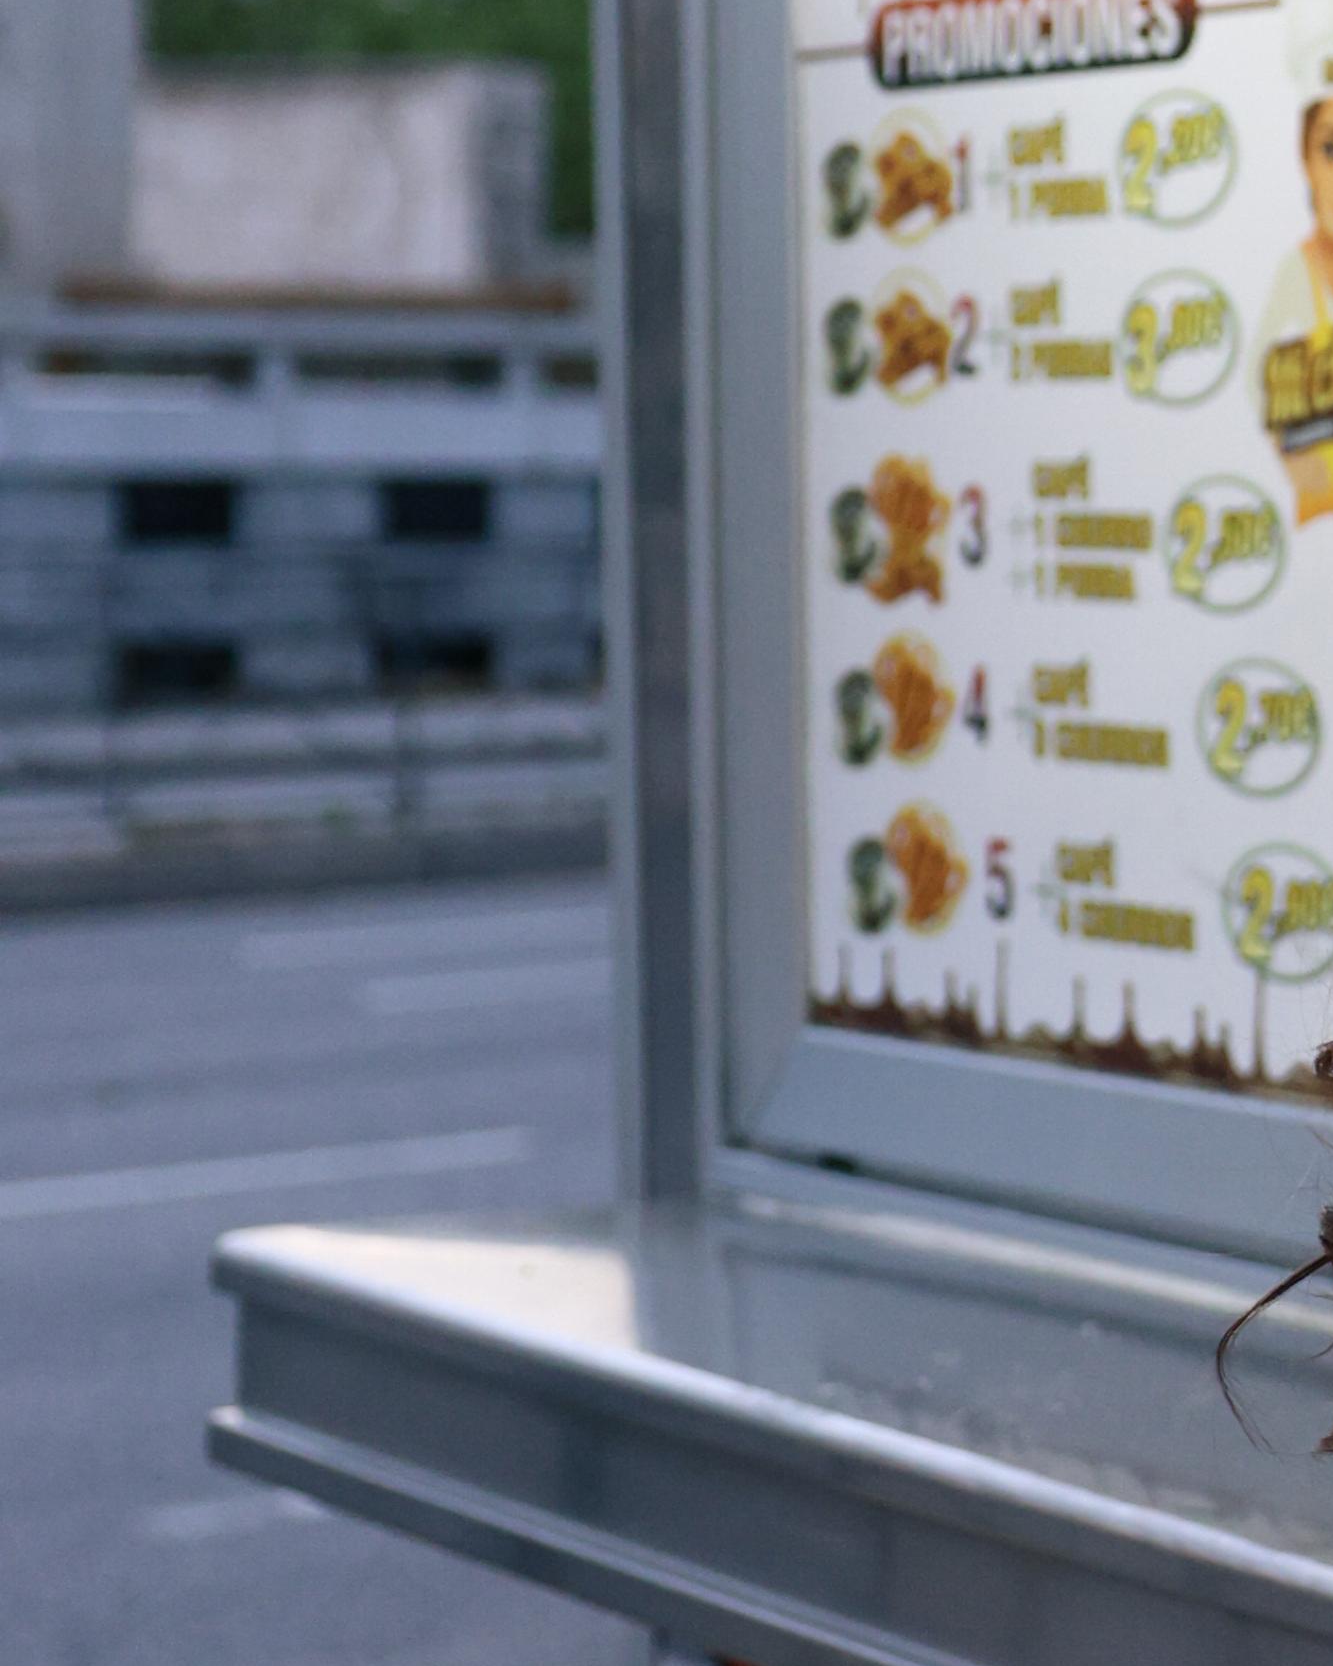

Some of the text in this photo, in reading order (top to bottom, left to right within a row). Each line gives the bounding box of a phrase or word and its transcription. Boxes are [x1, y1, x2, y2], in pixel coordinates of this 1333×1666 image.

[951, 291, 978, 378] 2
[960, 483, 987, 567] 3
[985, 836, 1015, 920] 5
